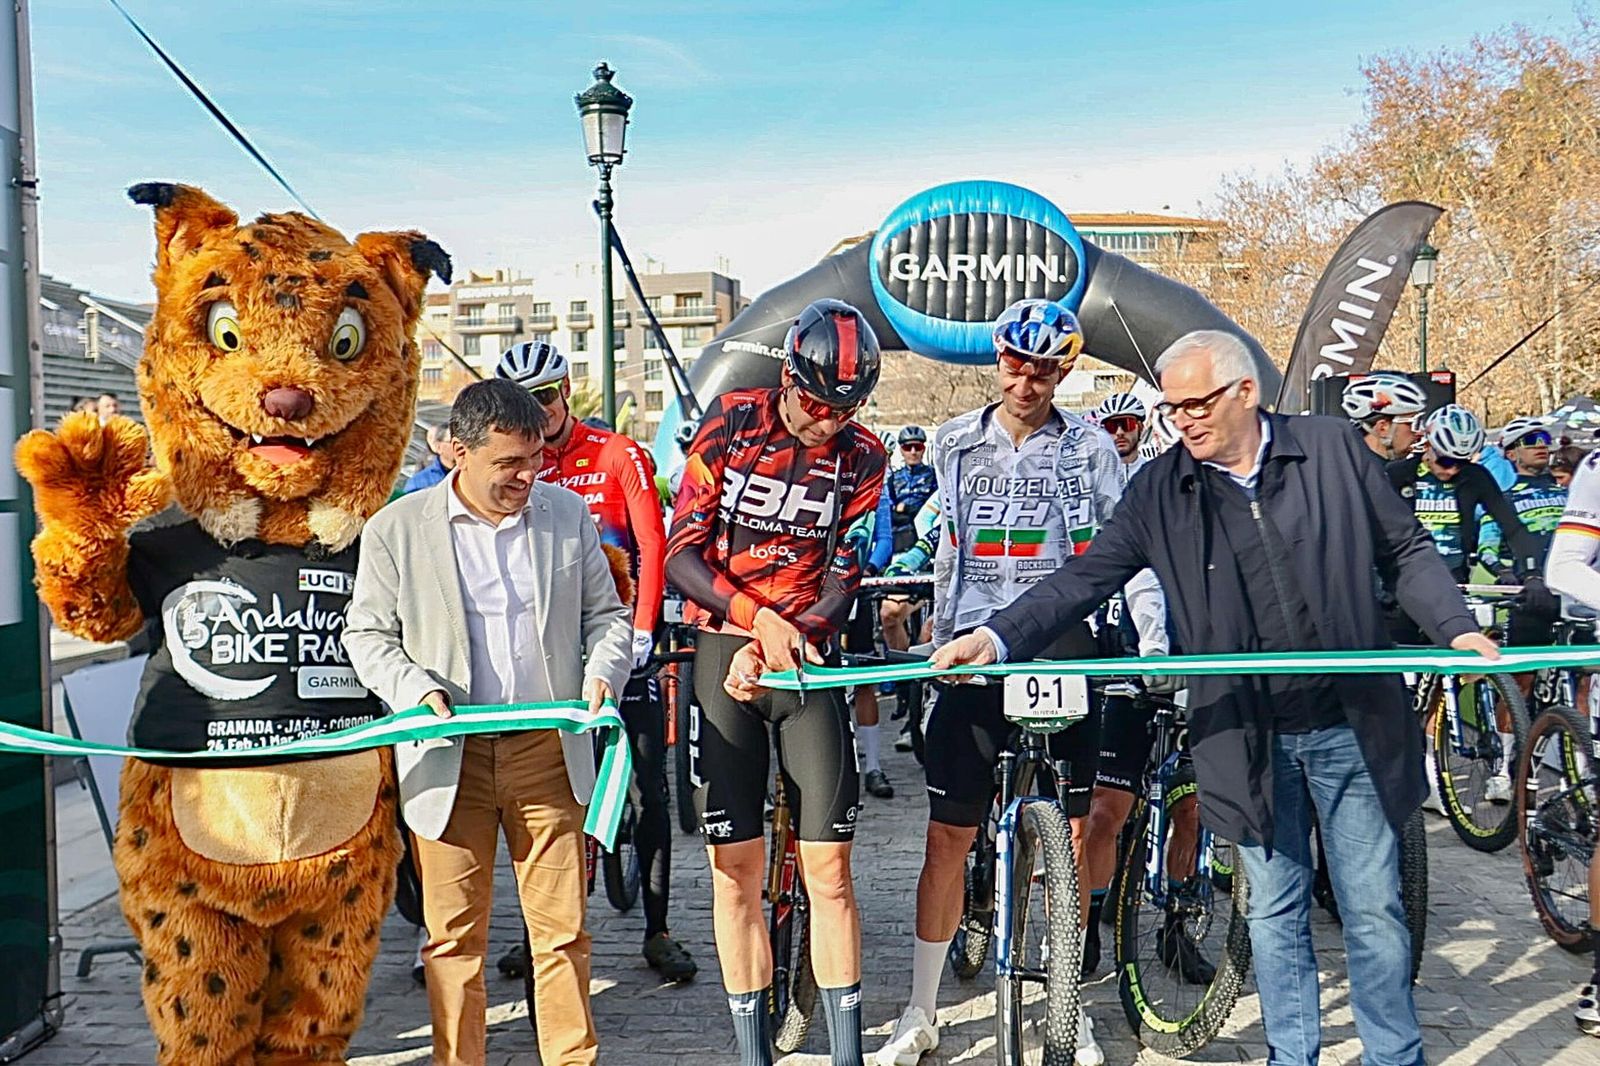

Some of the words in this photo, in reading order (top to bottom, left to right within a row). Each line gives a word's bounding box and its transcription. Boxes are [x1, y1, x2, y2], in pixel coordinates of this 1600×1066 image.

[722, 341, 789, 360] garmin.co
[967, 500, 1050, 526] BH
[788, 525, 827, 539] TEAM
[963, 559, 997, 569] SRAM
[307, 573, 340, 589] UCI
[211, 633, 289, 665] BIKE
[1026, 676, 1063, 709] 9-1
[206, 719, 274, 737] GRANADA
